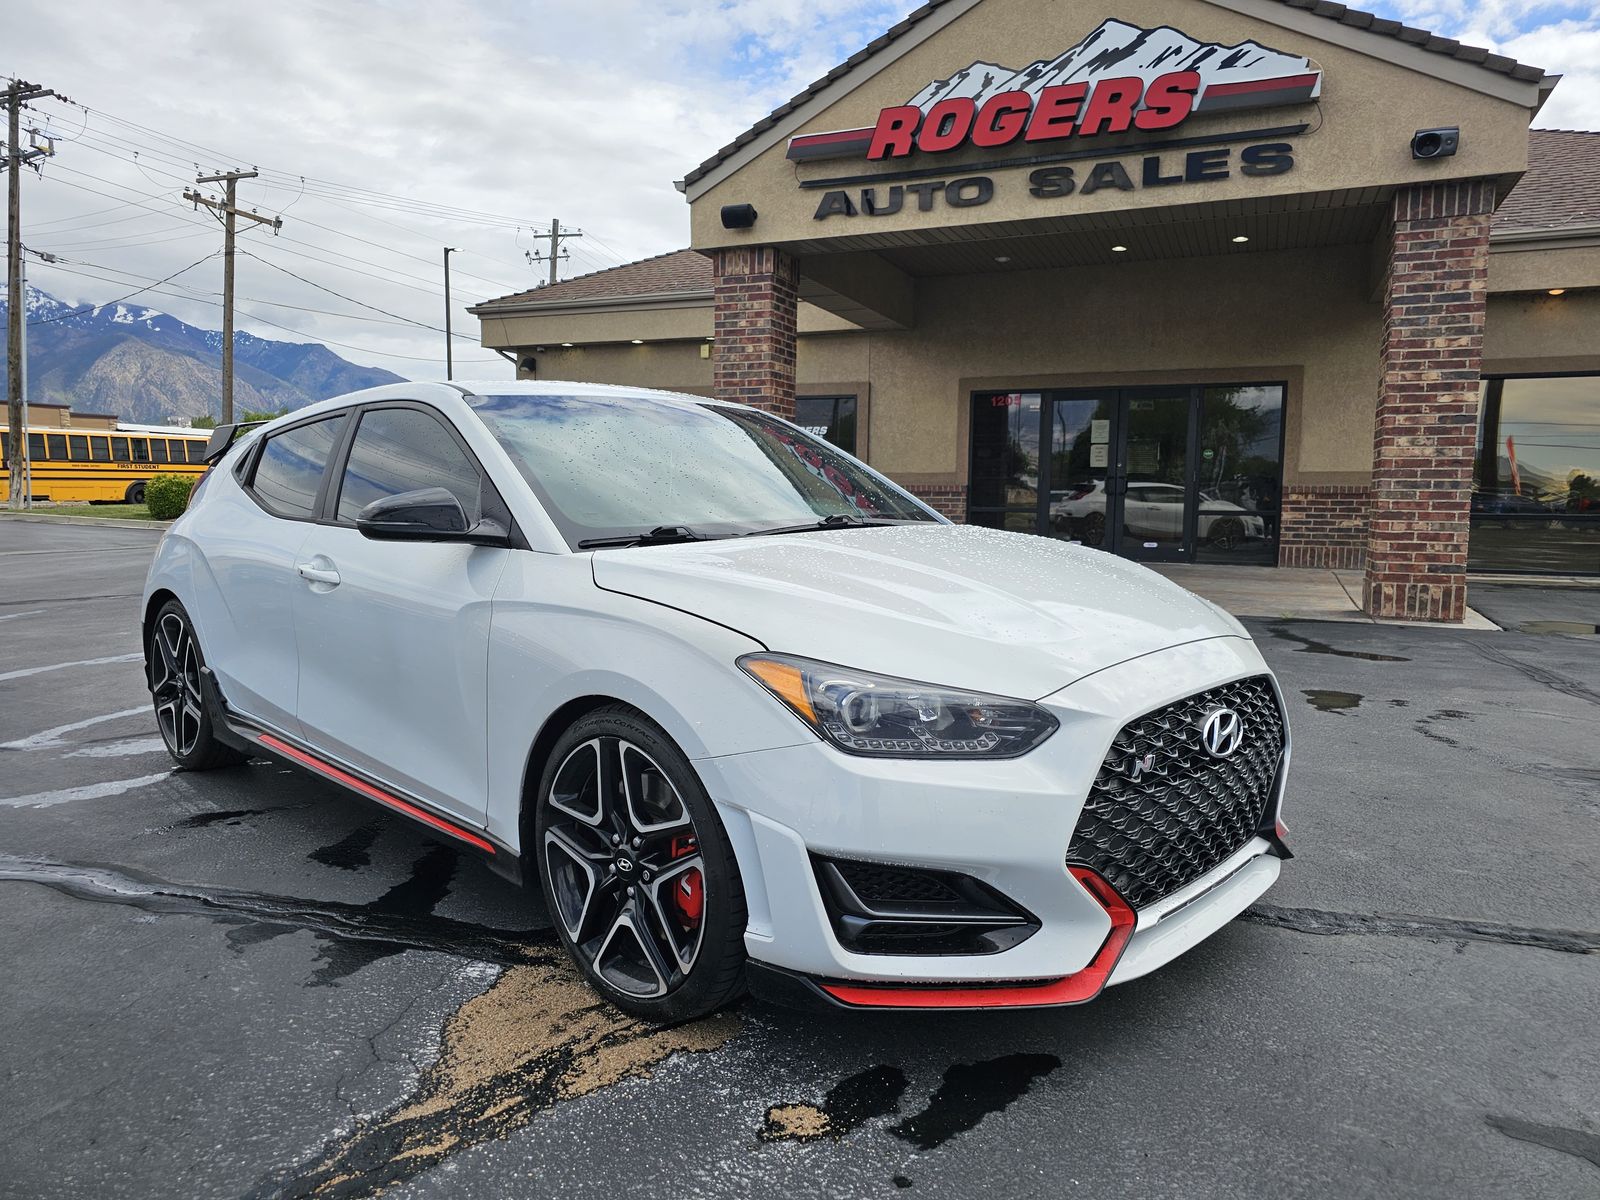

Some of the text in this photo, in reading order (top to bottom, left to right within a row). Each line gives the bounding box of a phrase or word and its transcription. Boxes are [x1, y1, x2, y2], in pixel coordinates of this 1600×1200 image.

[866, 71, 1201, 161] ROGERS
[813, 142, 1294, 220] AUTO SALES
